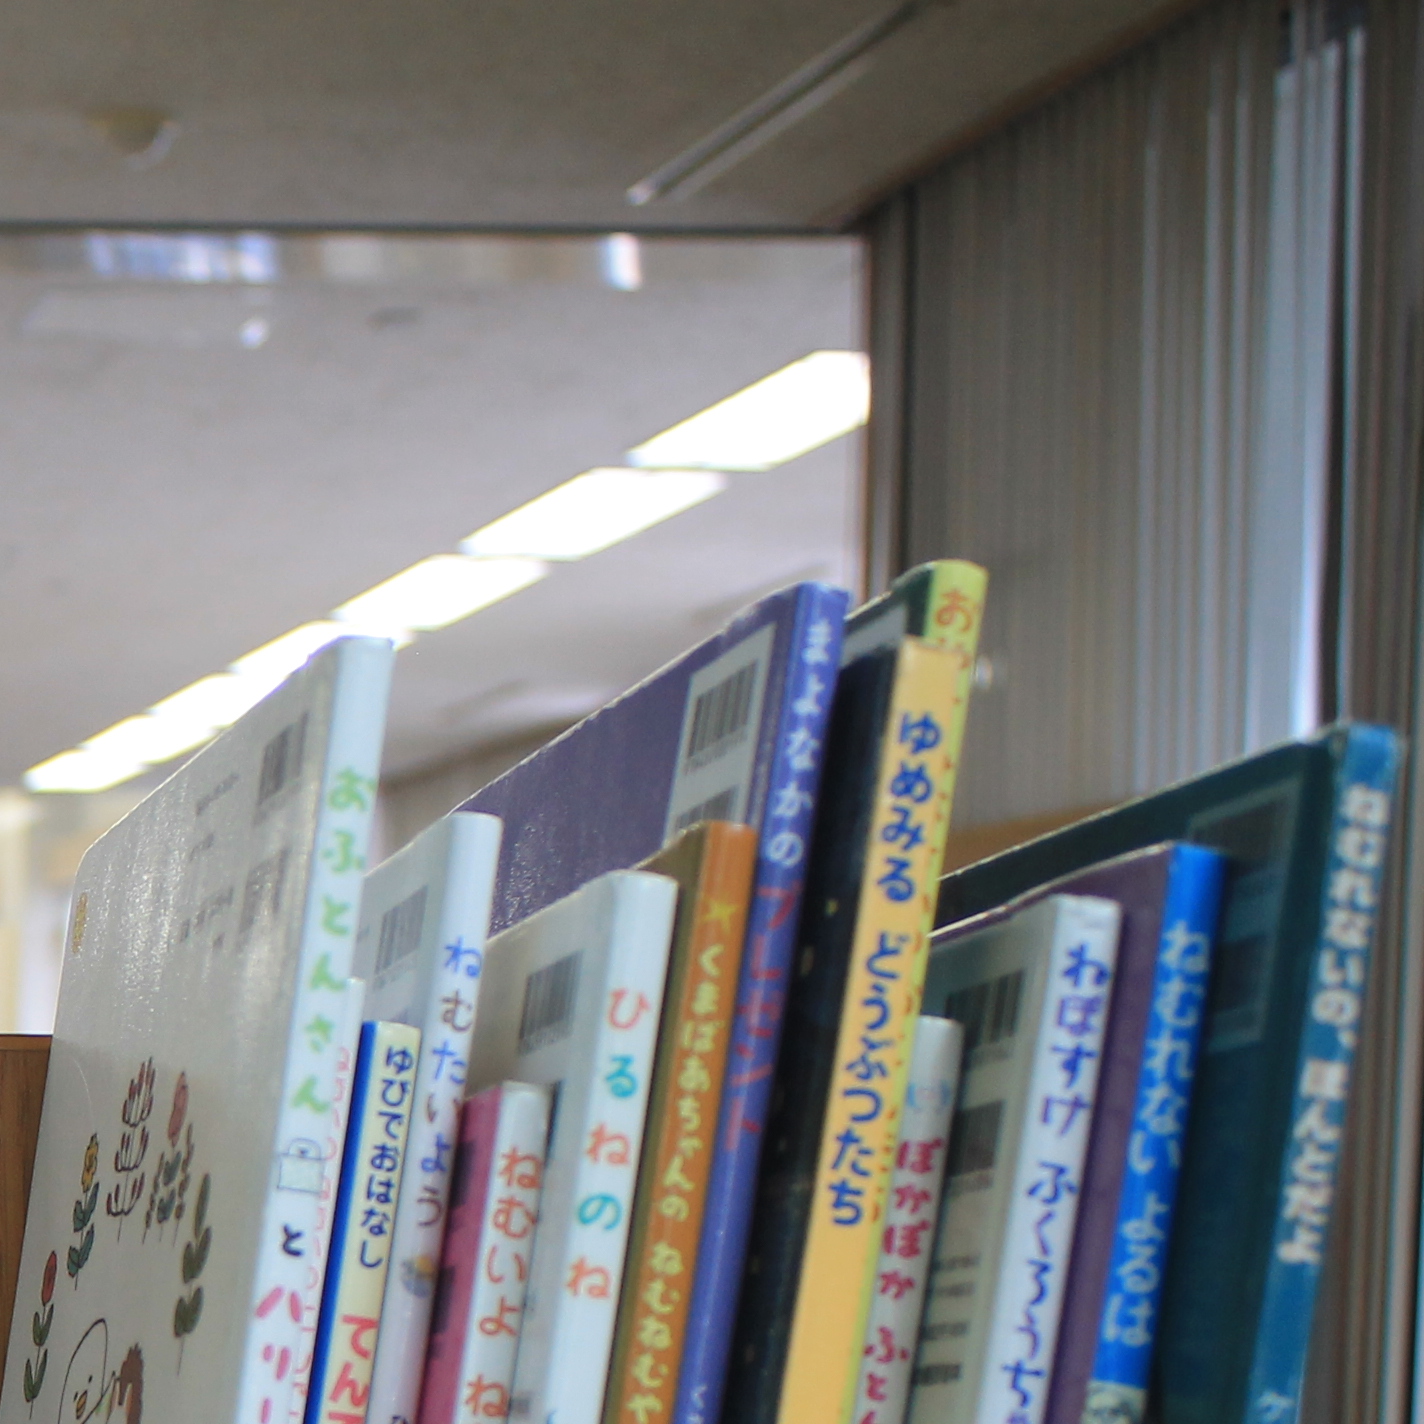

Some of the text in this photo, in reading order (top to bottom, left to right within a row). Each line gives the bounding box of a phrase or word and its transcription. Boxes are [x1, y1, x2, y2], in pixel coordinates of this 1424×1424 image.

[764, 619, 833, 869] まよなかの
[417, 938, 483, 1228] ねむたいよう
[830, 711, 942, 1227] ゆめみる どうぶつたち
[360, 1046, 415, 1270] ゆびでおはなし
[479, 1146, 543, 1338] ねむいよ
[566, 987, 651, 1300] ひるねのね
[1103, 920, 1211, 1347] ねむれない よるは
